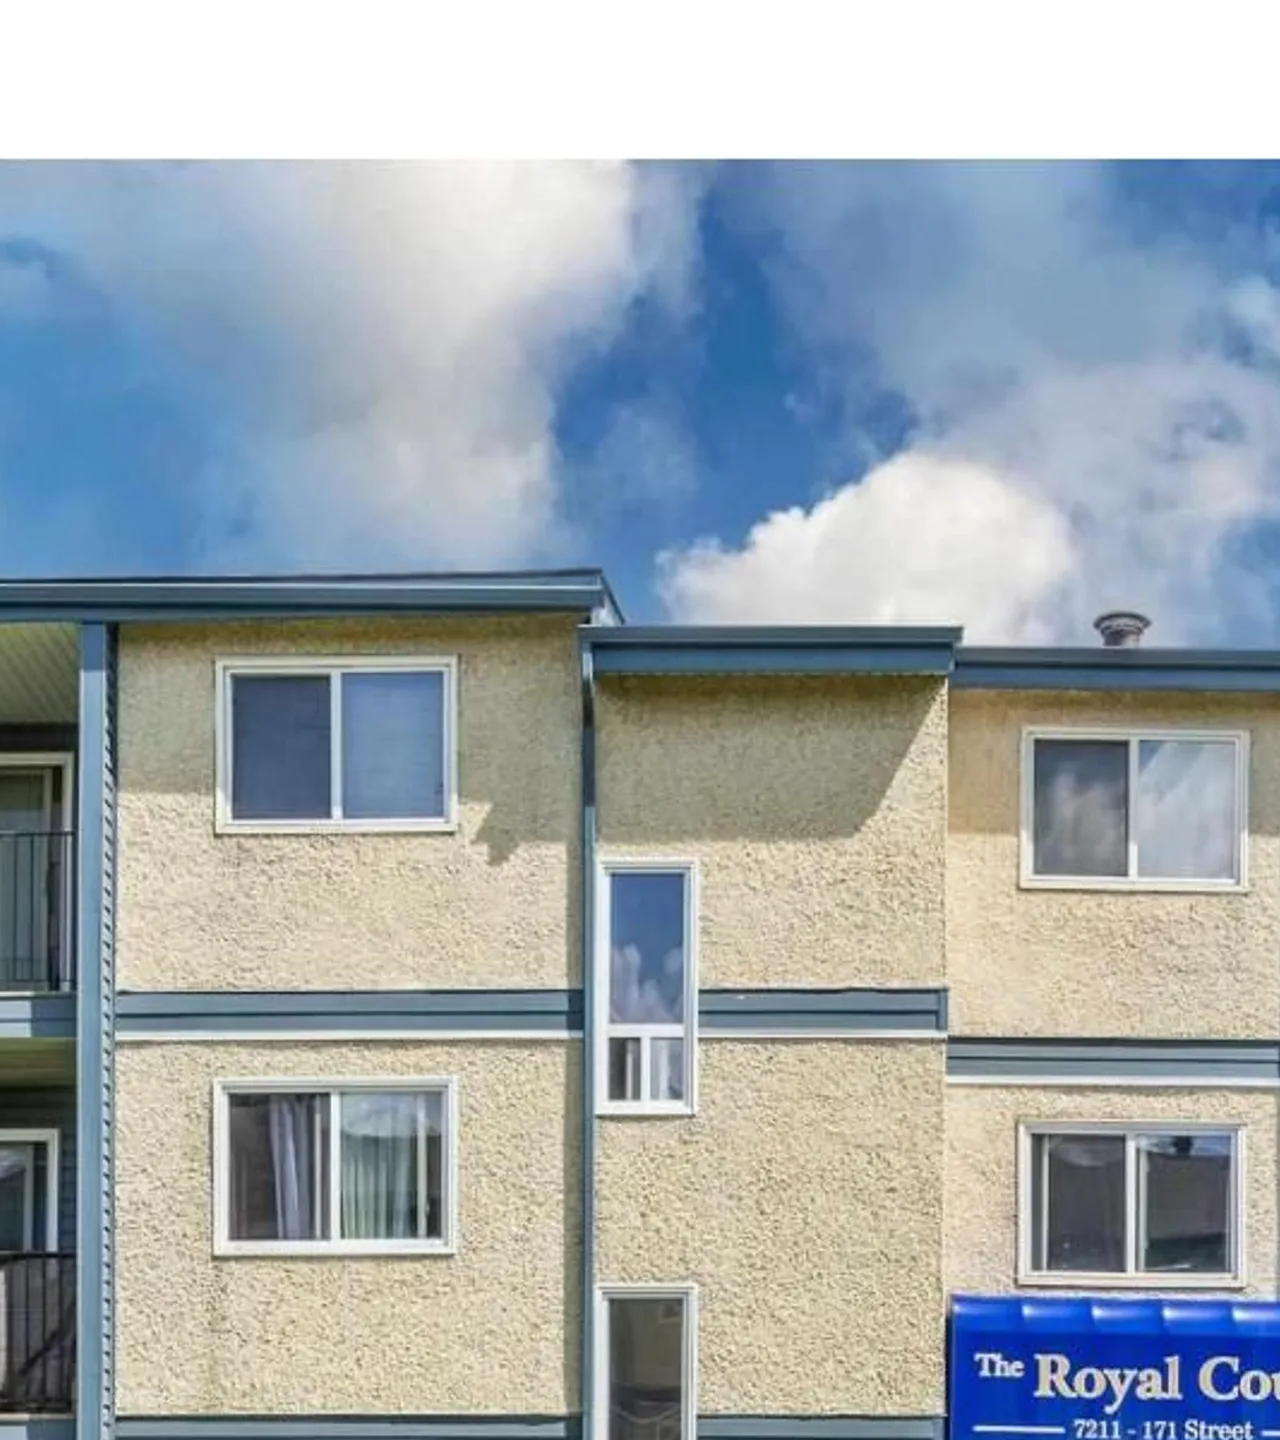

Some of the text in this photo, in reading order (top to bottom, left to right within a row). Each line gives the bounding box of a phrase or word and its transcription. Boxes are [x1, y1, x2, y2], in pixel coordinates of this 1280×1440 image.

[973, 1353, 1025, 1377] The
[1033, 1354, 1183, 1414] Royal
[1073, 1418, 1121, 1439] 7211
[1143, 1420, 1178, 1440] 171
[1184, 1419, 1254, 1440] Street
